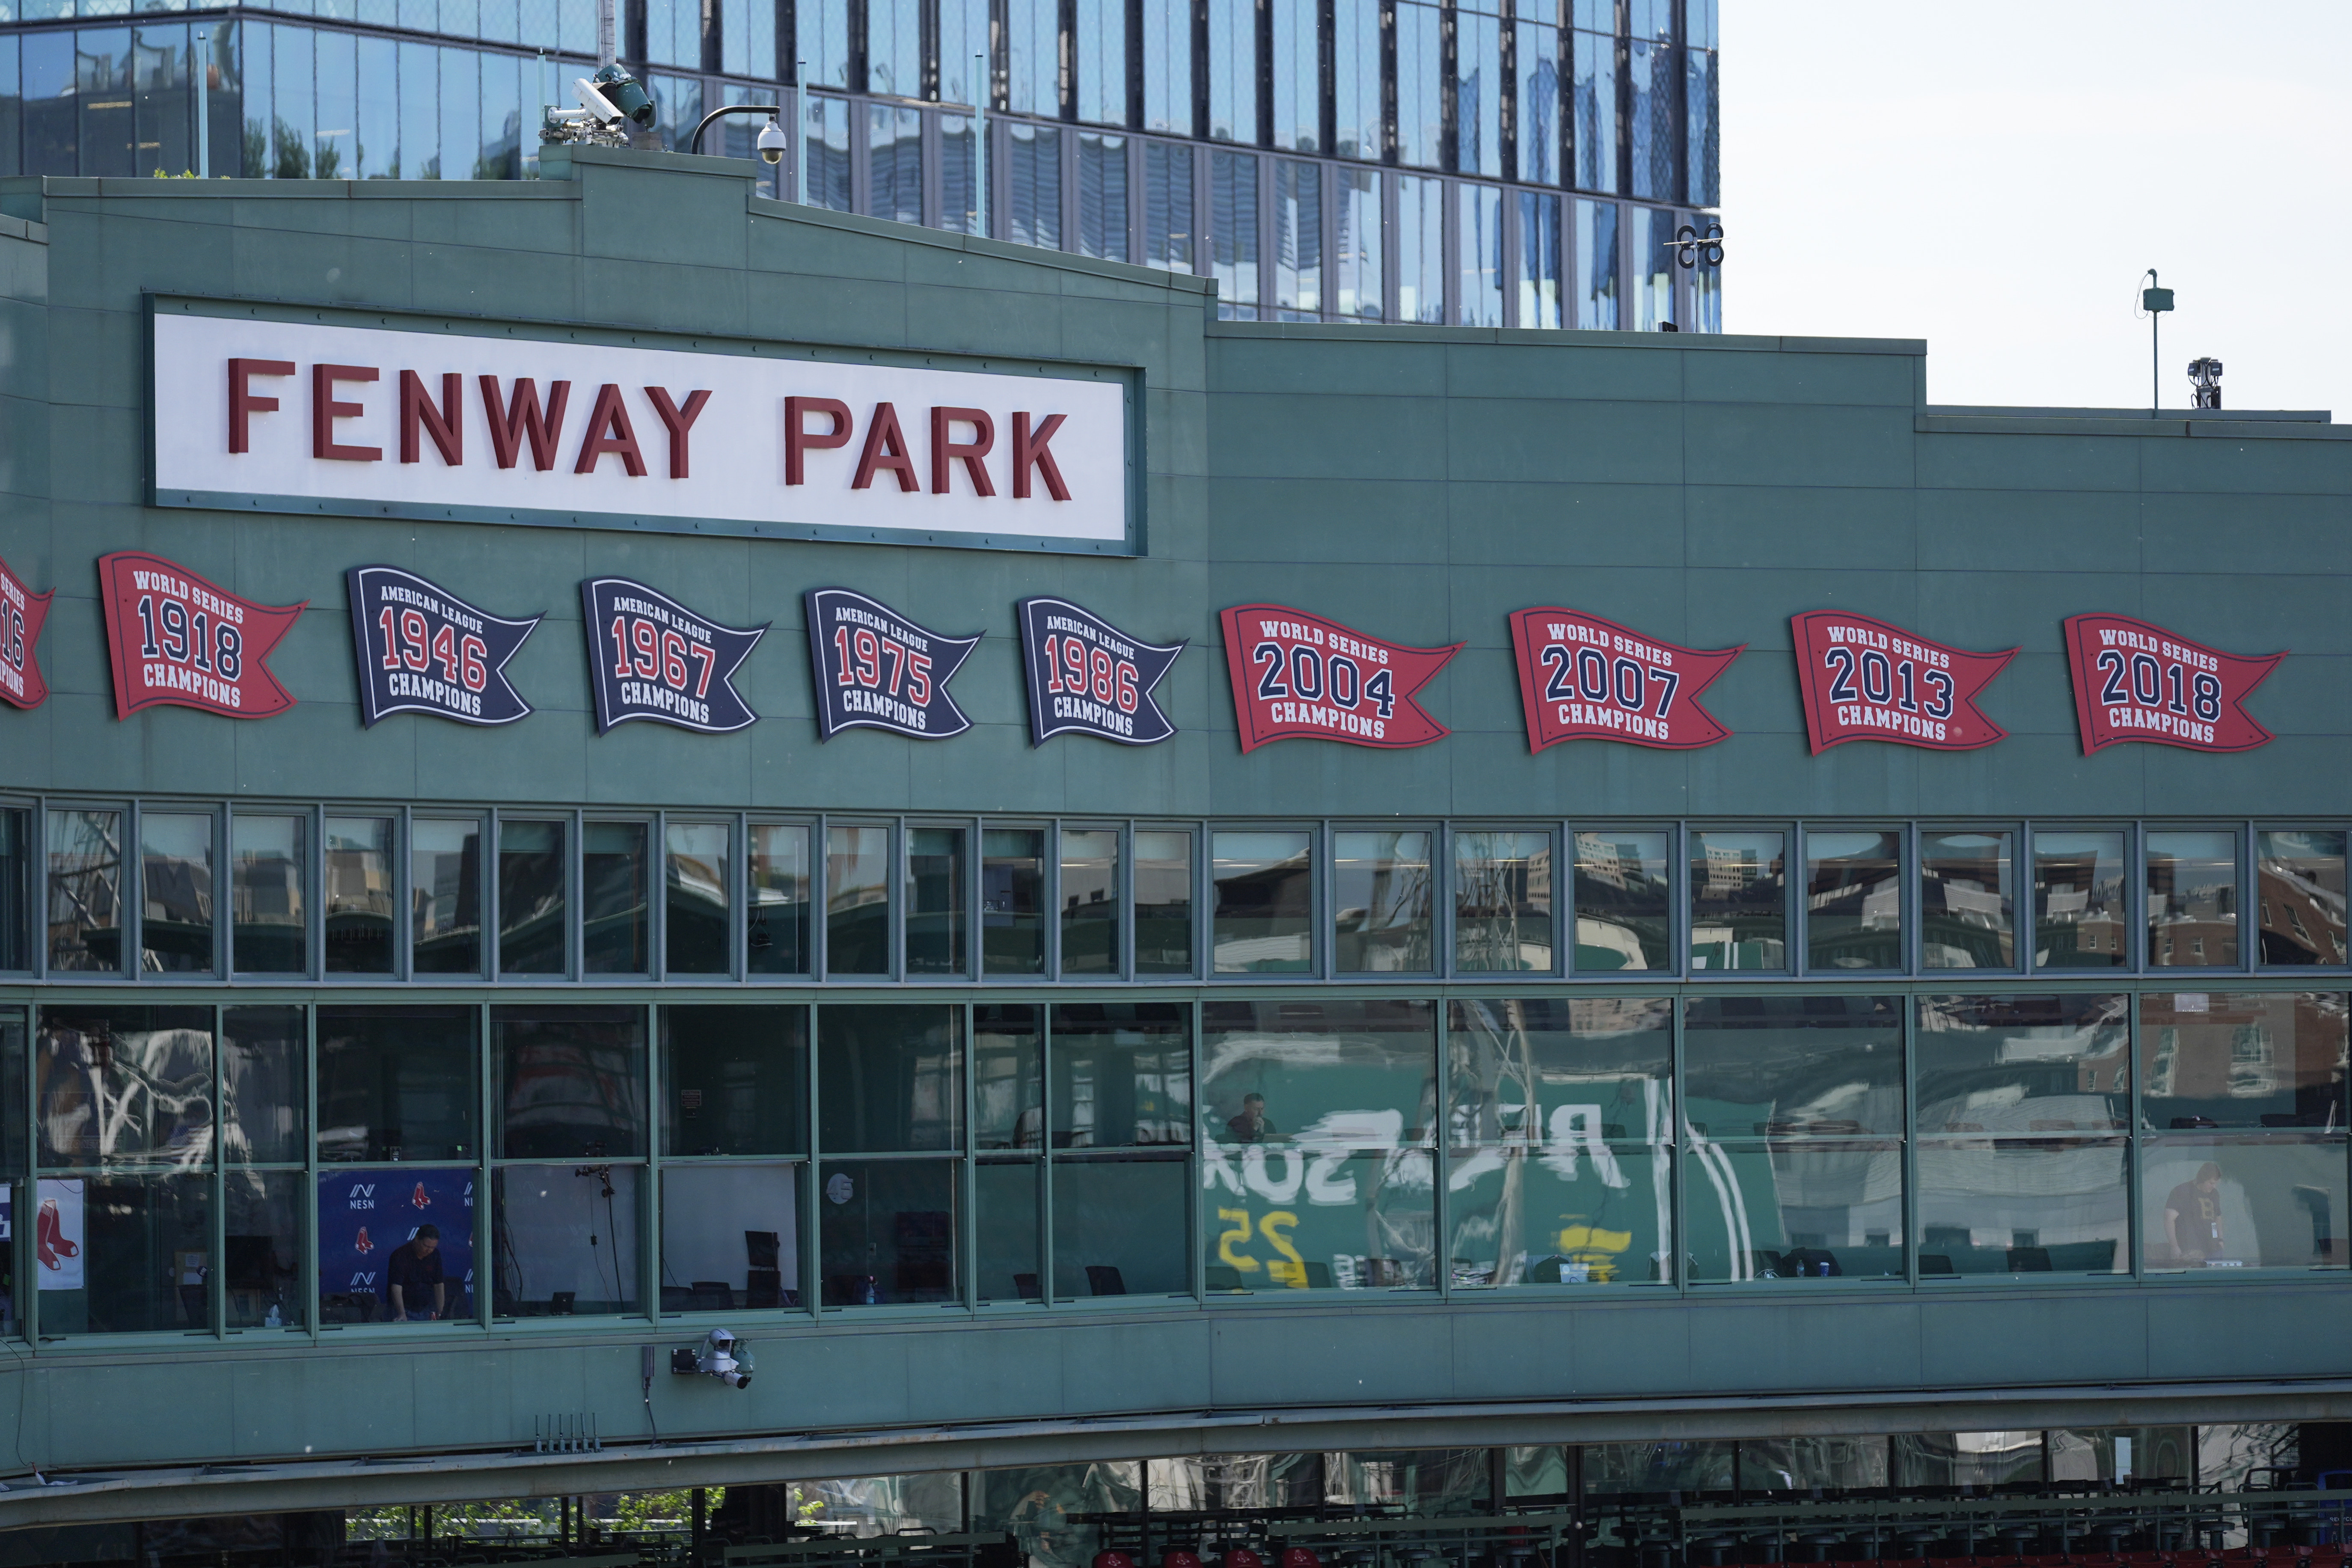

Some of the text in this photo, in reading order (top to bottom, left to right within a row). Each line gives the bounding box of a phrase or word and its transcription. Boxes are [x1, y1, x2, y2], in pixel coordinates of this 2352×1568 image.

[227, 357, 1072, 501] FENWAY PARK
[1, 572, 24, 611] SERIES
[133, 570, 244, 624] WORLD SERIES
[381, 585, 483, 634] AMERICAN LEAGUE
[0, 598, 24, 672] 16
[138, 594, 242, 682] 1918
[614, 597, 712, 644] AMERICAN LEAGUE
[835, 607, 928, 652] AMERICAN LEAGUE
[1047, 616, 1135, 660] AMERICAN LEAGUE
[379, 606, 487, 693] 1946
[612, 616, 716, 699] 1967
[1259, 621, 1388, 665] WORLD SERIES
[1547, 623, 1672, 667] WORLD SERIES
[1827, 626, 1950, 668] WORLD SERIES
[2099, 629, 2218, 672] WORLD SERIES
[0, 659, 24, 698] PIONS
[143, 663, 241, 708] CHAMPIONS
[834, 626, 932, 708] 1975
[1045, 634, 1139, 715] 1986
[1253, 641, 1396, 720] 2004
[1540, 644, 1680, 719] 2007
[1824, 646, 1954, 721] 2013
[2097, 649, 2222, 723] 2018
[389, 673, 481, 716] CHAMPIONS
[621, 682, 710, 724] CHAMPIONS
[843, 690, 927, 731] CHAMPIONS
[1054, 696, 1133, 736] CHAMPIONS
[1271, 702, 1385, 739] CHAMPIONS
[1558, 704, 1669, 740] CHAMPIONS
[1838, 705, 1946, 741] CHAMPIONS
[2109, 707, 2214, 743] CHAMPIONS
[350, 1200, 374, 1209] NESN
